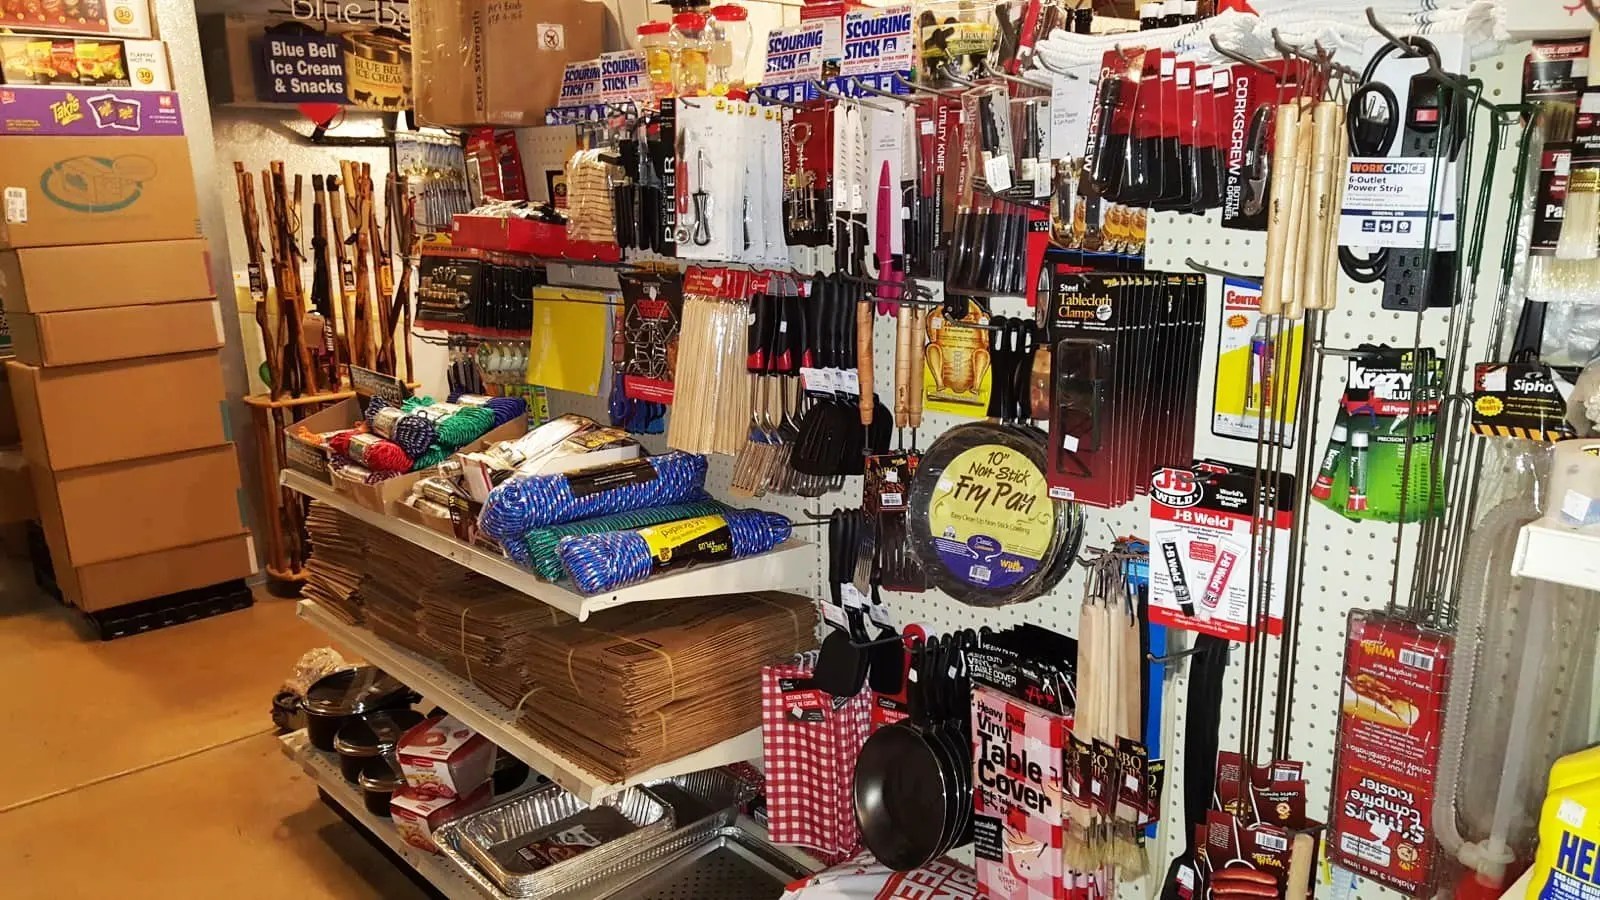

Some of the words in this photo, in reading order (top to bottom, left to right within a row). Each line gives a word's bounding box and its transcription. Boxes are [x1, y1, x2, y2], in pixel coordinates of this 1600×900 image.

[846, 14, 911, 39] SCOURING
[272, 41, 305, 57] Blue
[308, 43, 336, 58] Bell
[472, 11, 482, 73] Strength
[768, 31, 823, 53] SCOURING
[844, 40, 880, 60] STICK
[270, 60, 293, 75] Ice
[297, 61, 343, 76] Cream
[355, 58, 380, 72] BLUE
[602, 58, 646, 75] SCOURING
[766, 53, 797, 72] STICK
[355, 69, 370, 79] ICE
[275, 78, 287, 93] &
[291, 79, 344, 94] Snacks
[561, 83, 583, 97] STICK
[602, 77, 627, 91] STICK
[1532, 80, 1540, 90] 2
[475, 77, 483, 111] Extra
[50, 98, 80, 123] Takis
[1084, 67, 1108, 172] CSCREW
[937, 105, 947, 142] UTILITY
[1229, 77, 1249, 175] CORKSCREW
[782, 106, 790, 173] RKSCREW
[936, 143, 946, 172] KNIFE
[1351, 162, 1426, 174] WORKCHOICE
[1228, 176, 1237, 185] &
[1348, 184, 1377, 192] Power
[1379, 184, 1403, 193] Strip
[1349, 176, 1387, 184] 6-Outlet
[664, 156, 675, 243] PEELER
[1224, 185, 1234, 220] OPENER
[1231, 185, 1241, 217] BOTTLE
[1060, 283, 1079, 292] Steel
[1058, 292, 1112, 307] Tablecloth
[1058, 306, 1095, 320] Clamps
[1513, 379, 1554, 394] Sipho
[987, 451, 1010, 466] 10"
[954, 475, 992, 513] Fry
[991, 482, 1037, 515] Pan
[1155, 489, 1193, 505] WELD
[1216, 493, 1248, 504] Strongest
[1220, 488, 1244, 497] World's
[1173, 509, 1192, 521] J-B
[1194, 512, 1229, 527] Weld
[968, 664, 992, 676] TABLE
[993, 670, 1017, 685] COVER
[977, 701, 1004, 722] Heavy
[976, 712, 1012, 743] Vinyl
[976, 729, 1043, 783] Table
[1408, 761, 1431, 775] candy
[978, 758, 1052, 814] Cover
[1359, 777, 1414, 805] toaster
[889, 861, 954, 900] FEE
